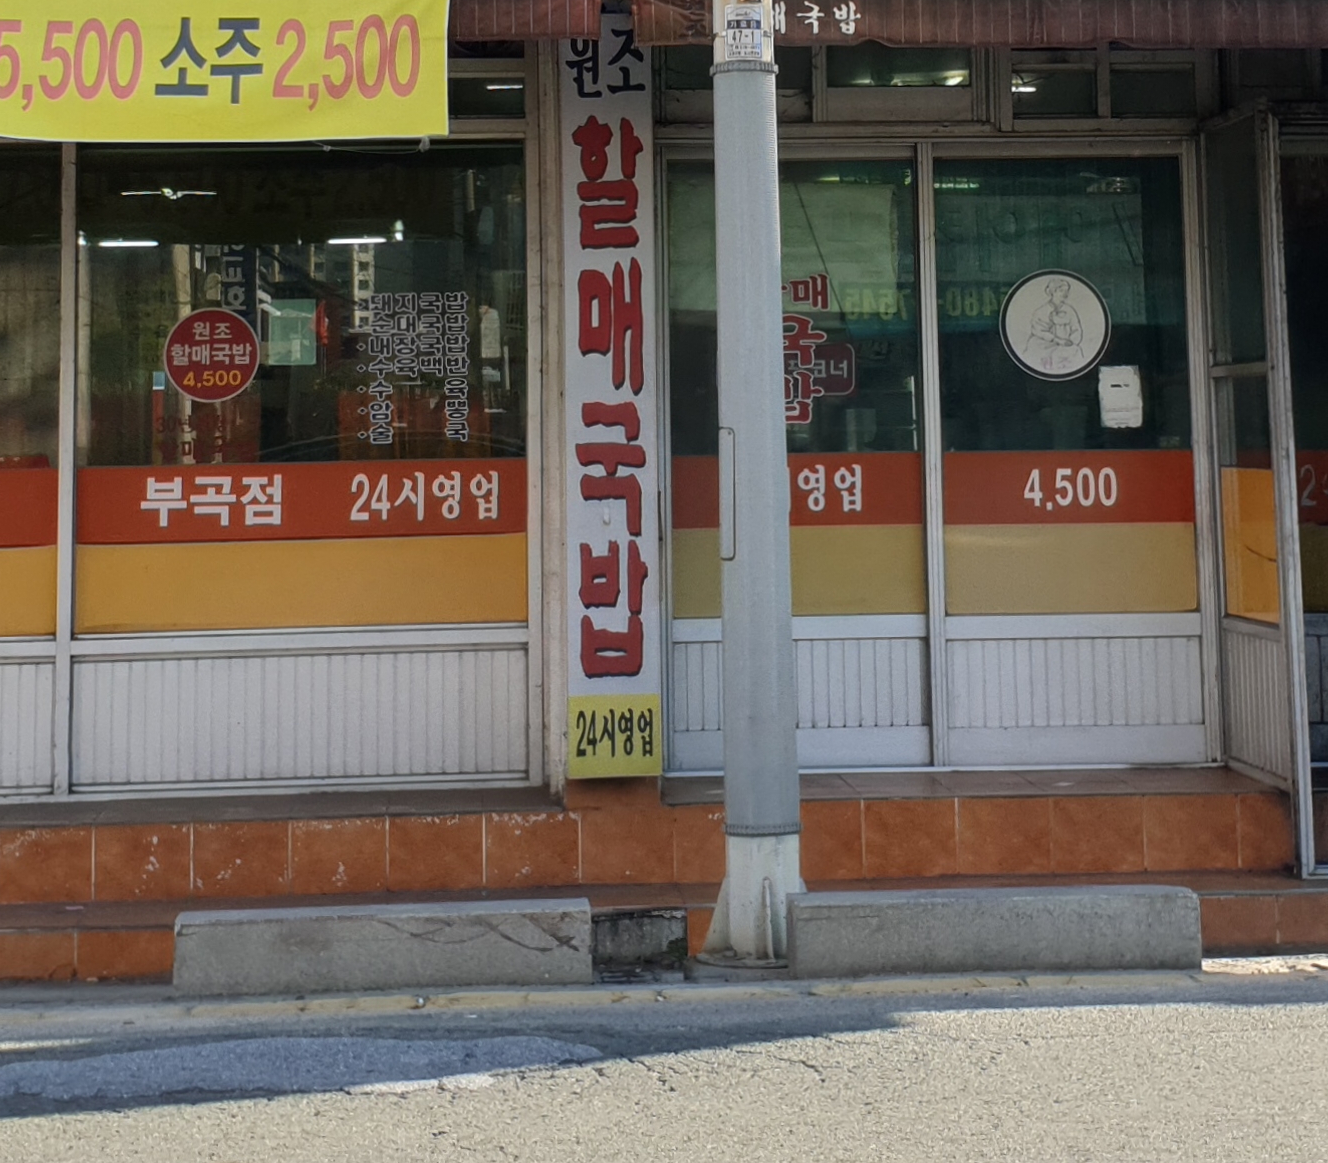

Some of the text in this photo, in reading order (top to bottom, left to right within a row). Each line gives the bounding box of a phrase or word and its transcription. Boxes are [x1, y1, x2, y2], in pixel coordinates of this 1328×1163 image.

[154, 16, 264, 105] 소주
[273, 14, 421, 112] 2,500
[566, 29, 646, 99] 원조
[369, 291, 469, 314] 돼지국밥
[192, 321, 233, 341] 원조
[370, 313, 470, 335] 순대국밥
[170, 342, 253, 366] 할매국밥
[368, 334, 470, 356] 내장국밥
[182, 369, 242, 388] 4,500
[368, 355, 470, 378] 수육백반
[571, 113, 647, 680] 할매국밥
[140, 474, 284, 527] 부곡점
[349, 470, 500, 522] 24시영업
[575, 706, 655, 760] 24시영업
